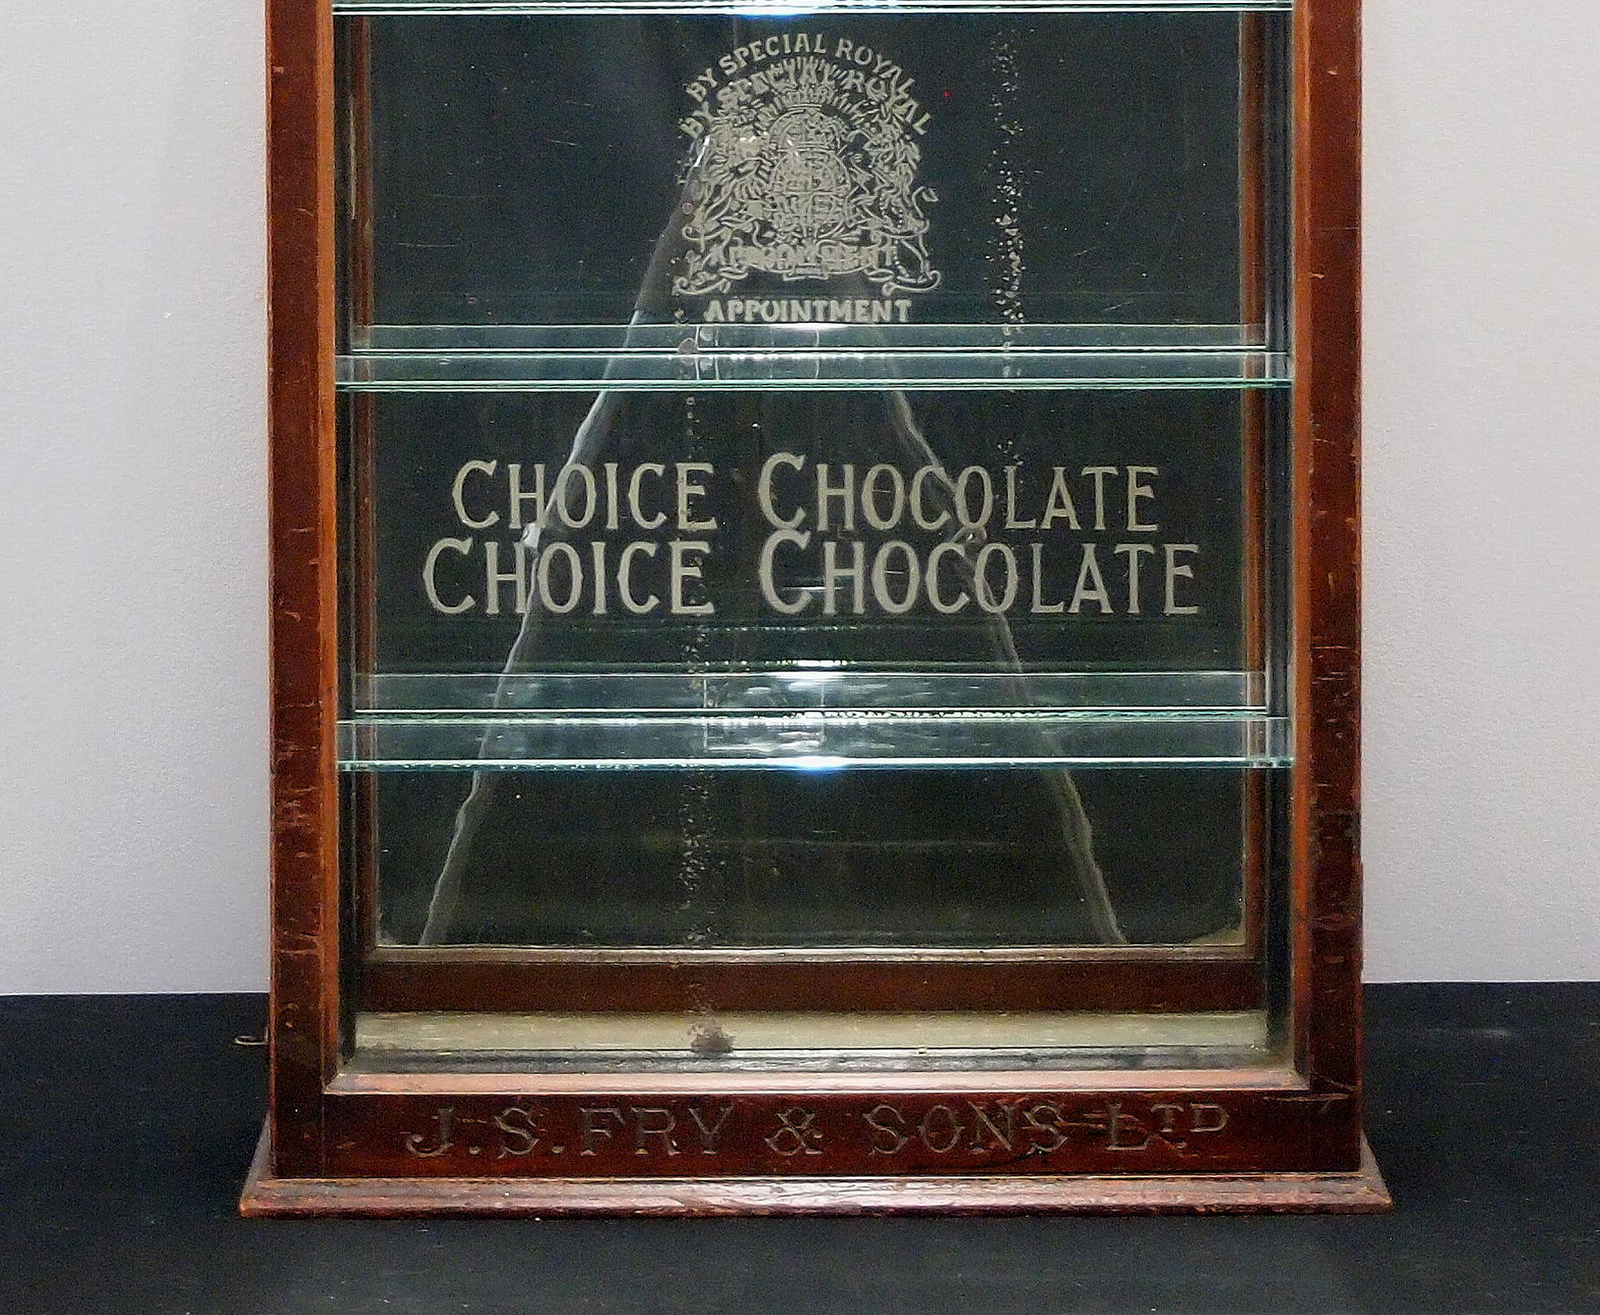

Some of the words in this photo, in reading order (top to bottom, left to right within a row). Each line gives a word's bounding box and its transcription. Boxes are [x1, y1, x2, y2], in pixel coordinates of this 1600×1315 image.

[685, 67, 718, 102] BY
[718, 33, 827, 75] SPECIAL
[835, 37, 915, 99] ROYAL
[703, 298, 913, 323] APPOINTMENT
[452, 459, 719, 530] CHOICE
[758, 451, 1160, 531] CHOCOLATE
[422, 537, 715, 615] CHOICE
[758, 530, 1200, 616] CHOCOLATE
[763, 1105, 824, 1156] &
[863, 1101, 1069, 1156] SONS
